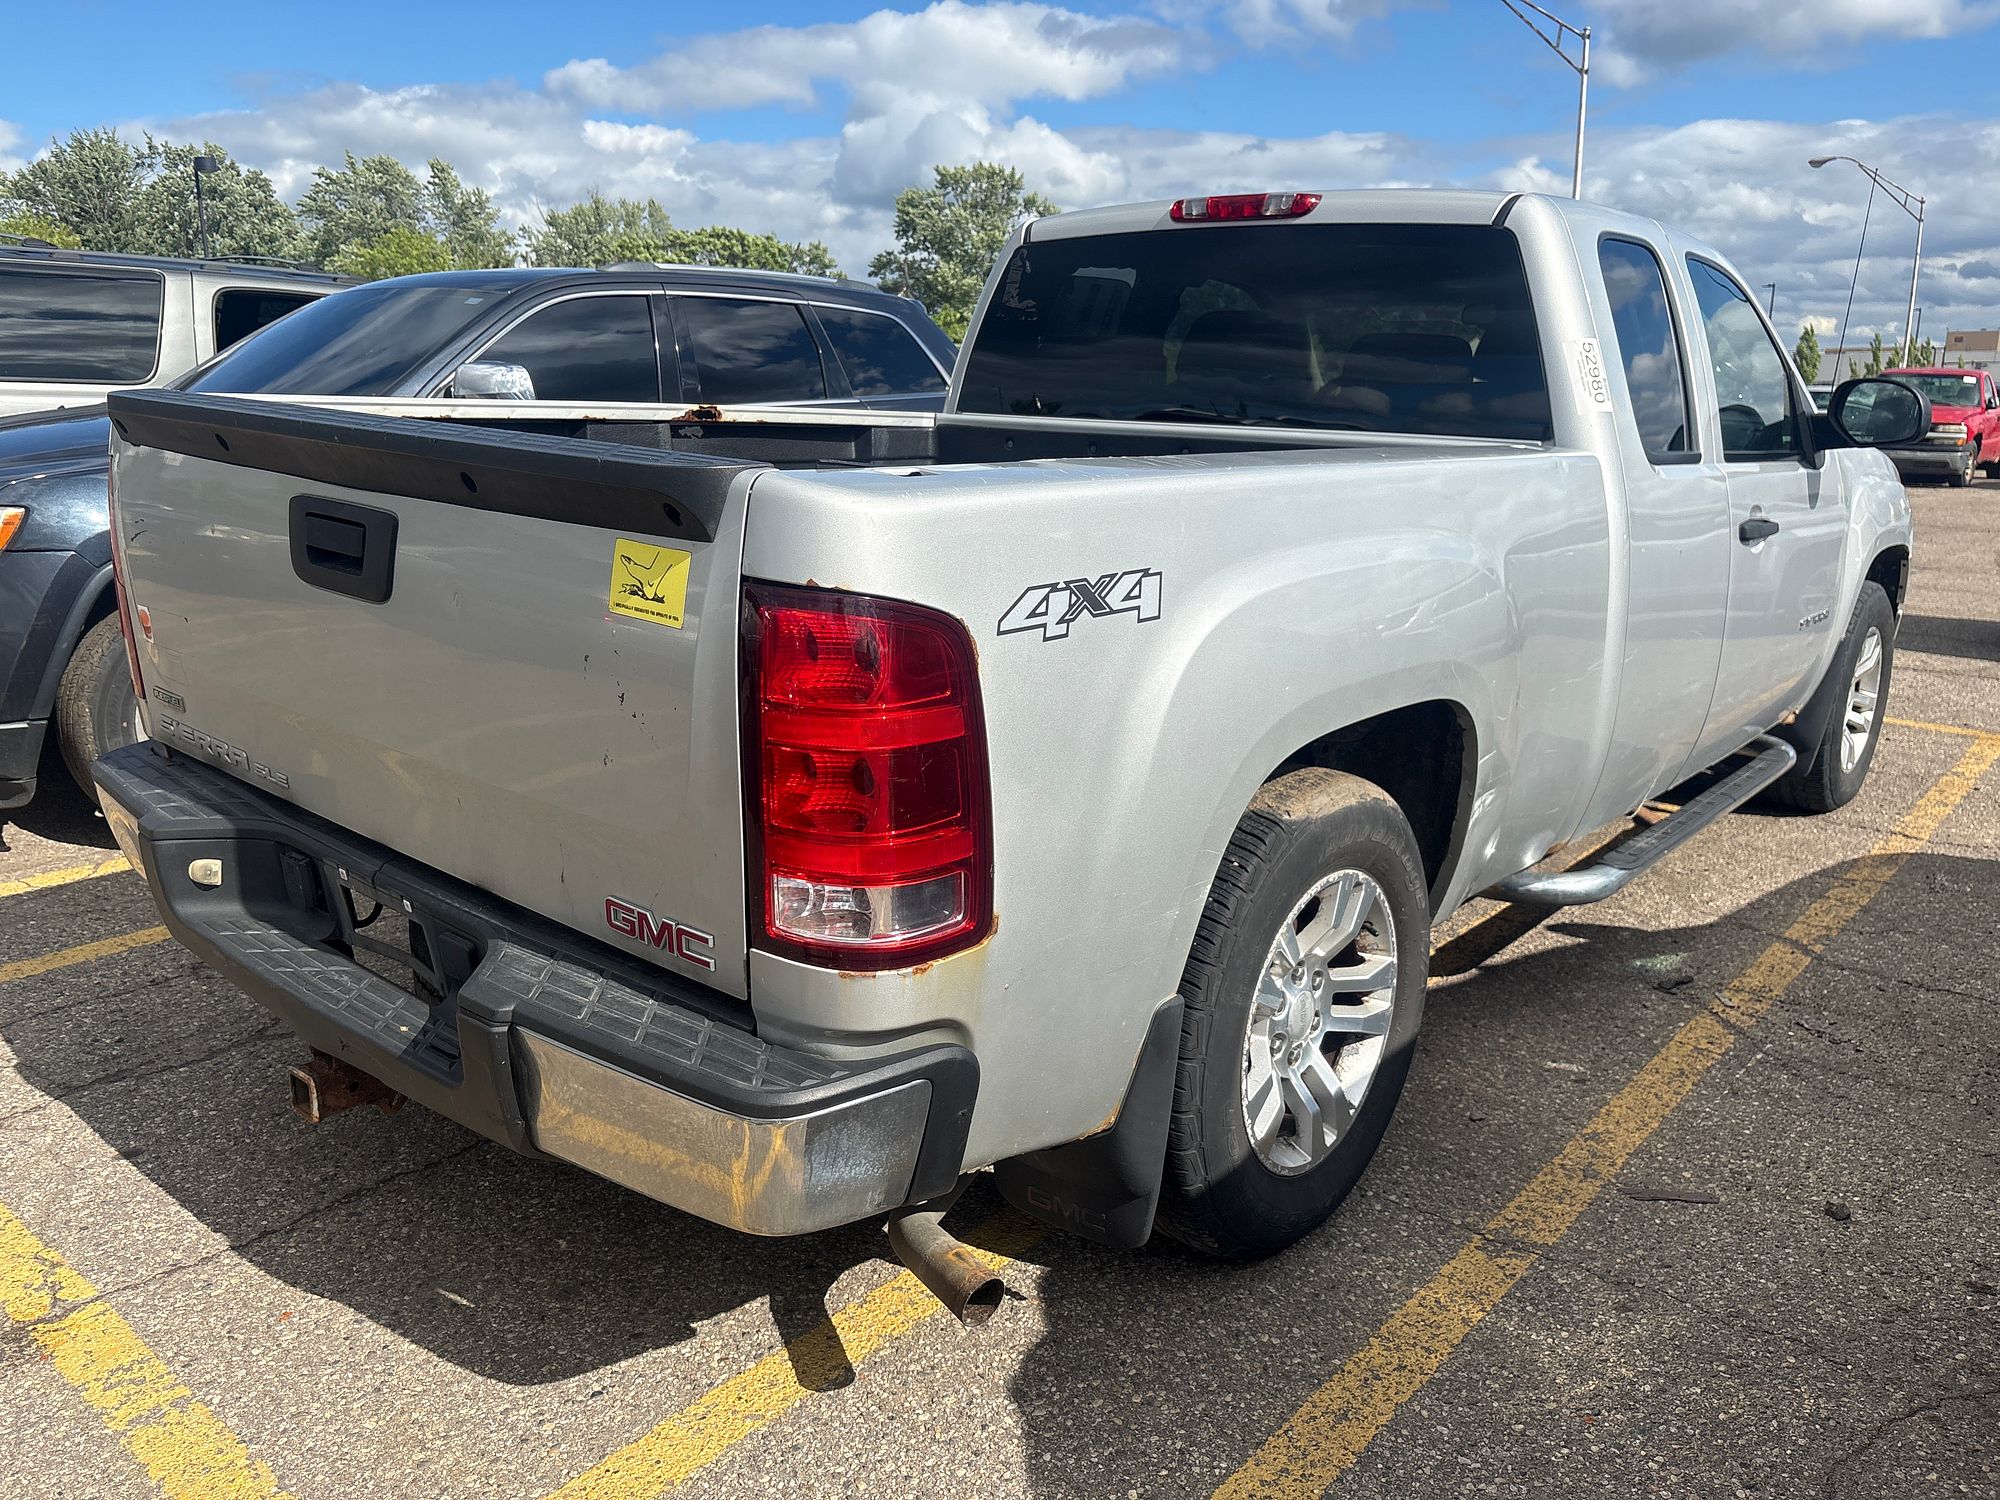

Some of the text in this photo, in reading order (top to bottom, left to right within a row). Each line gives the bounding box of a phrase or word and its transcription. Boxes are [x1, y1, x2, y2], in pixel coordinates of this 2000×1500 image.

[1582, 342, 1606, 403] 52980
[160, 713, 250, 771] SIERRA
[604, 895, 716, 971] GMC
